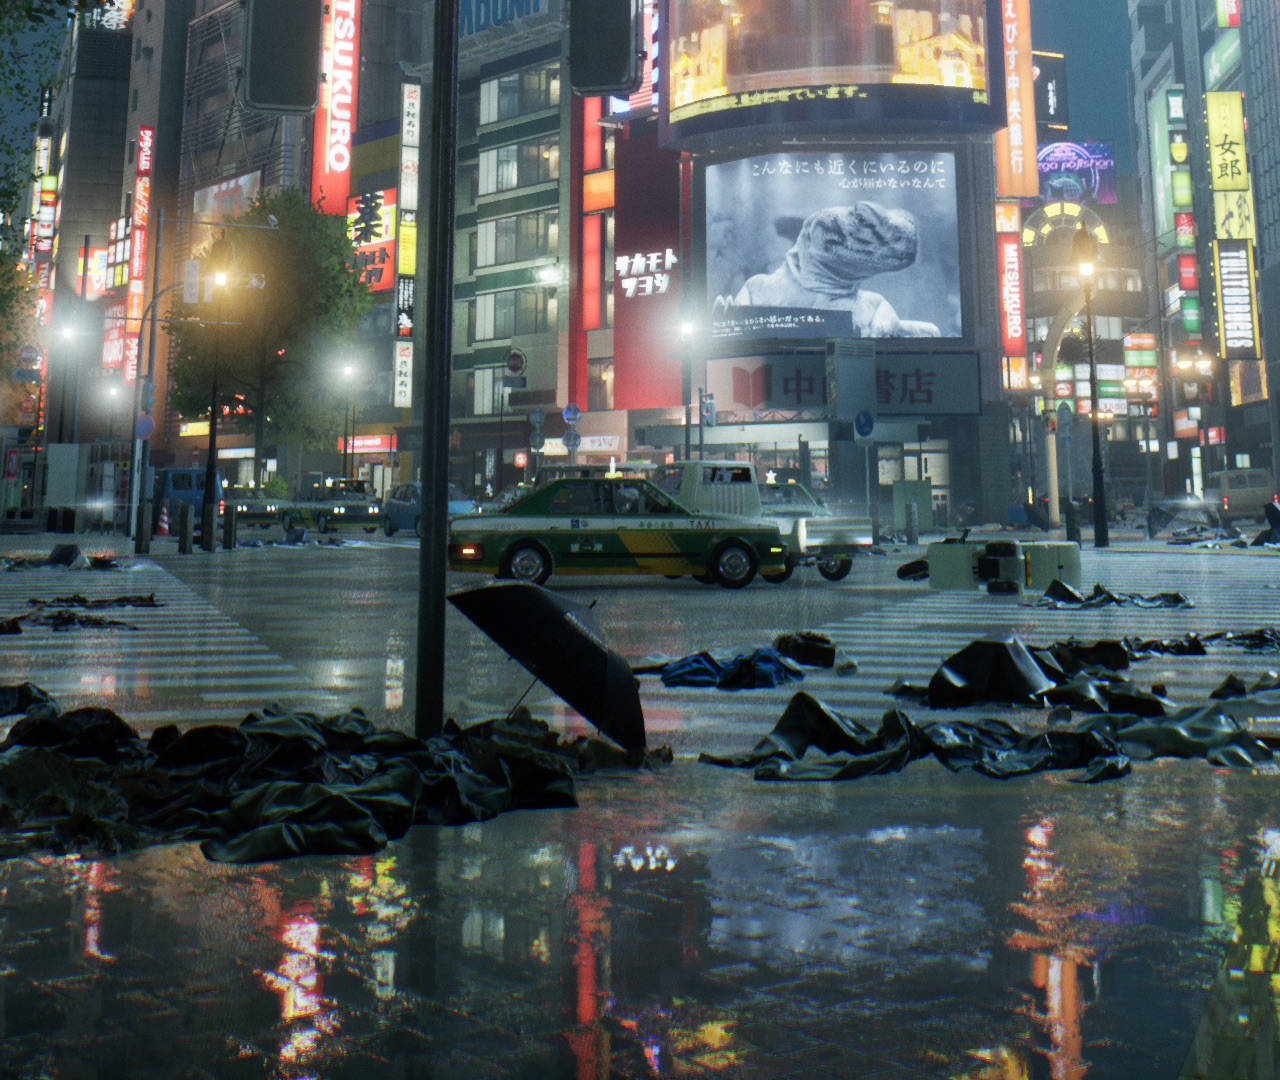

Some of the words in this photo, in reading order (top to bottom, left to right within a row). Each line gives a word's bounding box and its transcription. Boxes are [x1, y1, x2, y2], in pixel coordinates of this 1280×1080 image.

[752, 159, 946, 177] こんなにも近くにいるのに
[1005, 243, 1023, 339] MITSUKURO
[783, 368, 938, 406] 中書店
[690, 520, 715, 529] TAXI
